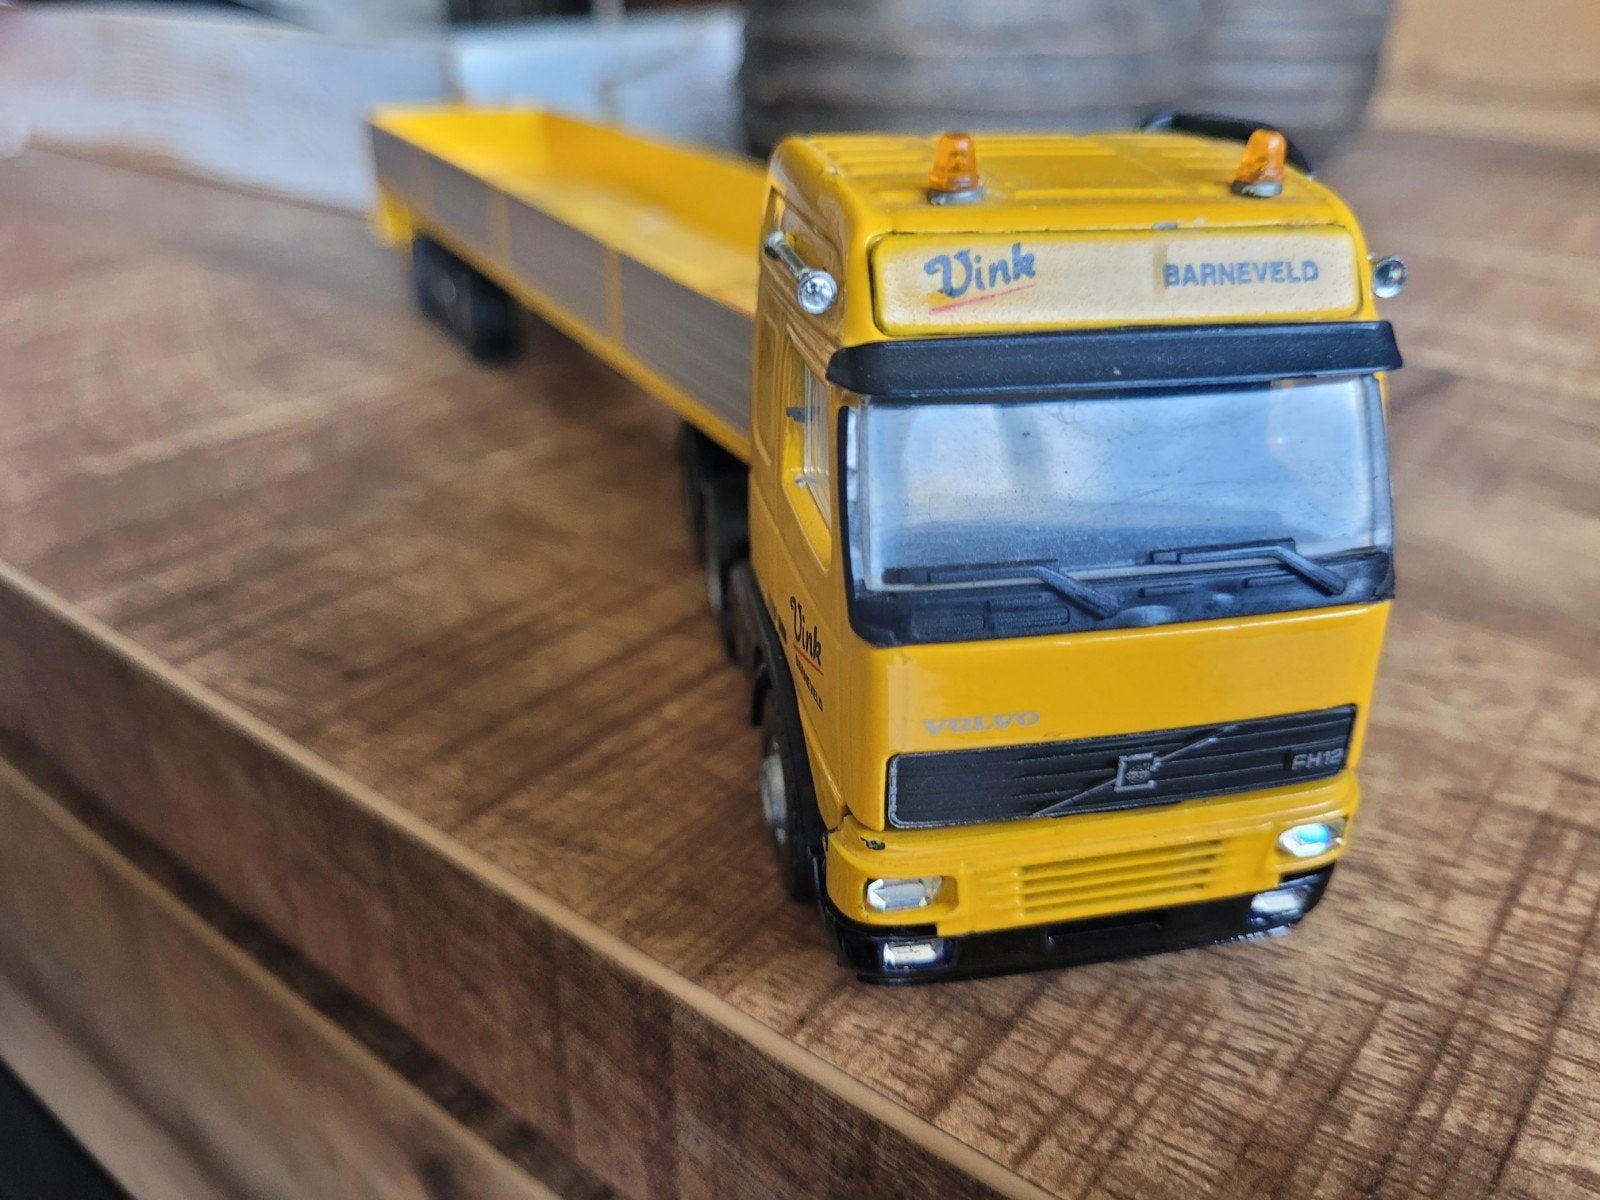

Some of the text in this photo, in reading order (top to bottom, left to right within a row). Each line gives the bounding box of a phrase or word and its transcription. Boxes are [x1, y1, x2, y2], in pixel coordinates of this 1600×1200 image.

[924, 242, 1319, 298] Vink BARNEVELD
[790, 596, 821, 666] Vink
[922, 710, 1039, 736] VOLVO
[1292, 748, 1344, 770] FH12
